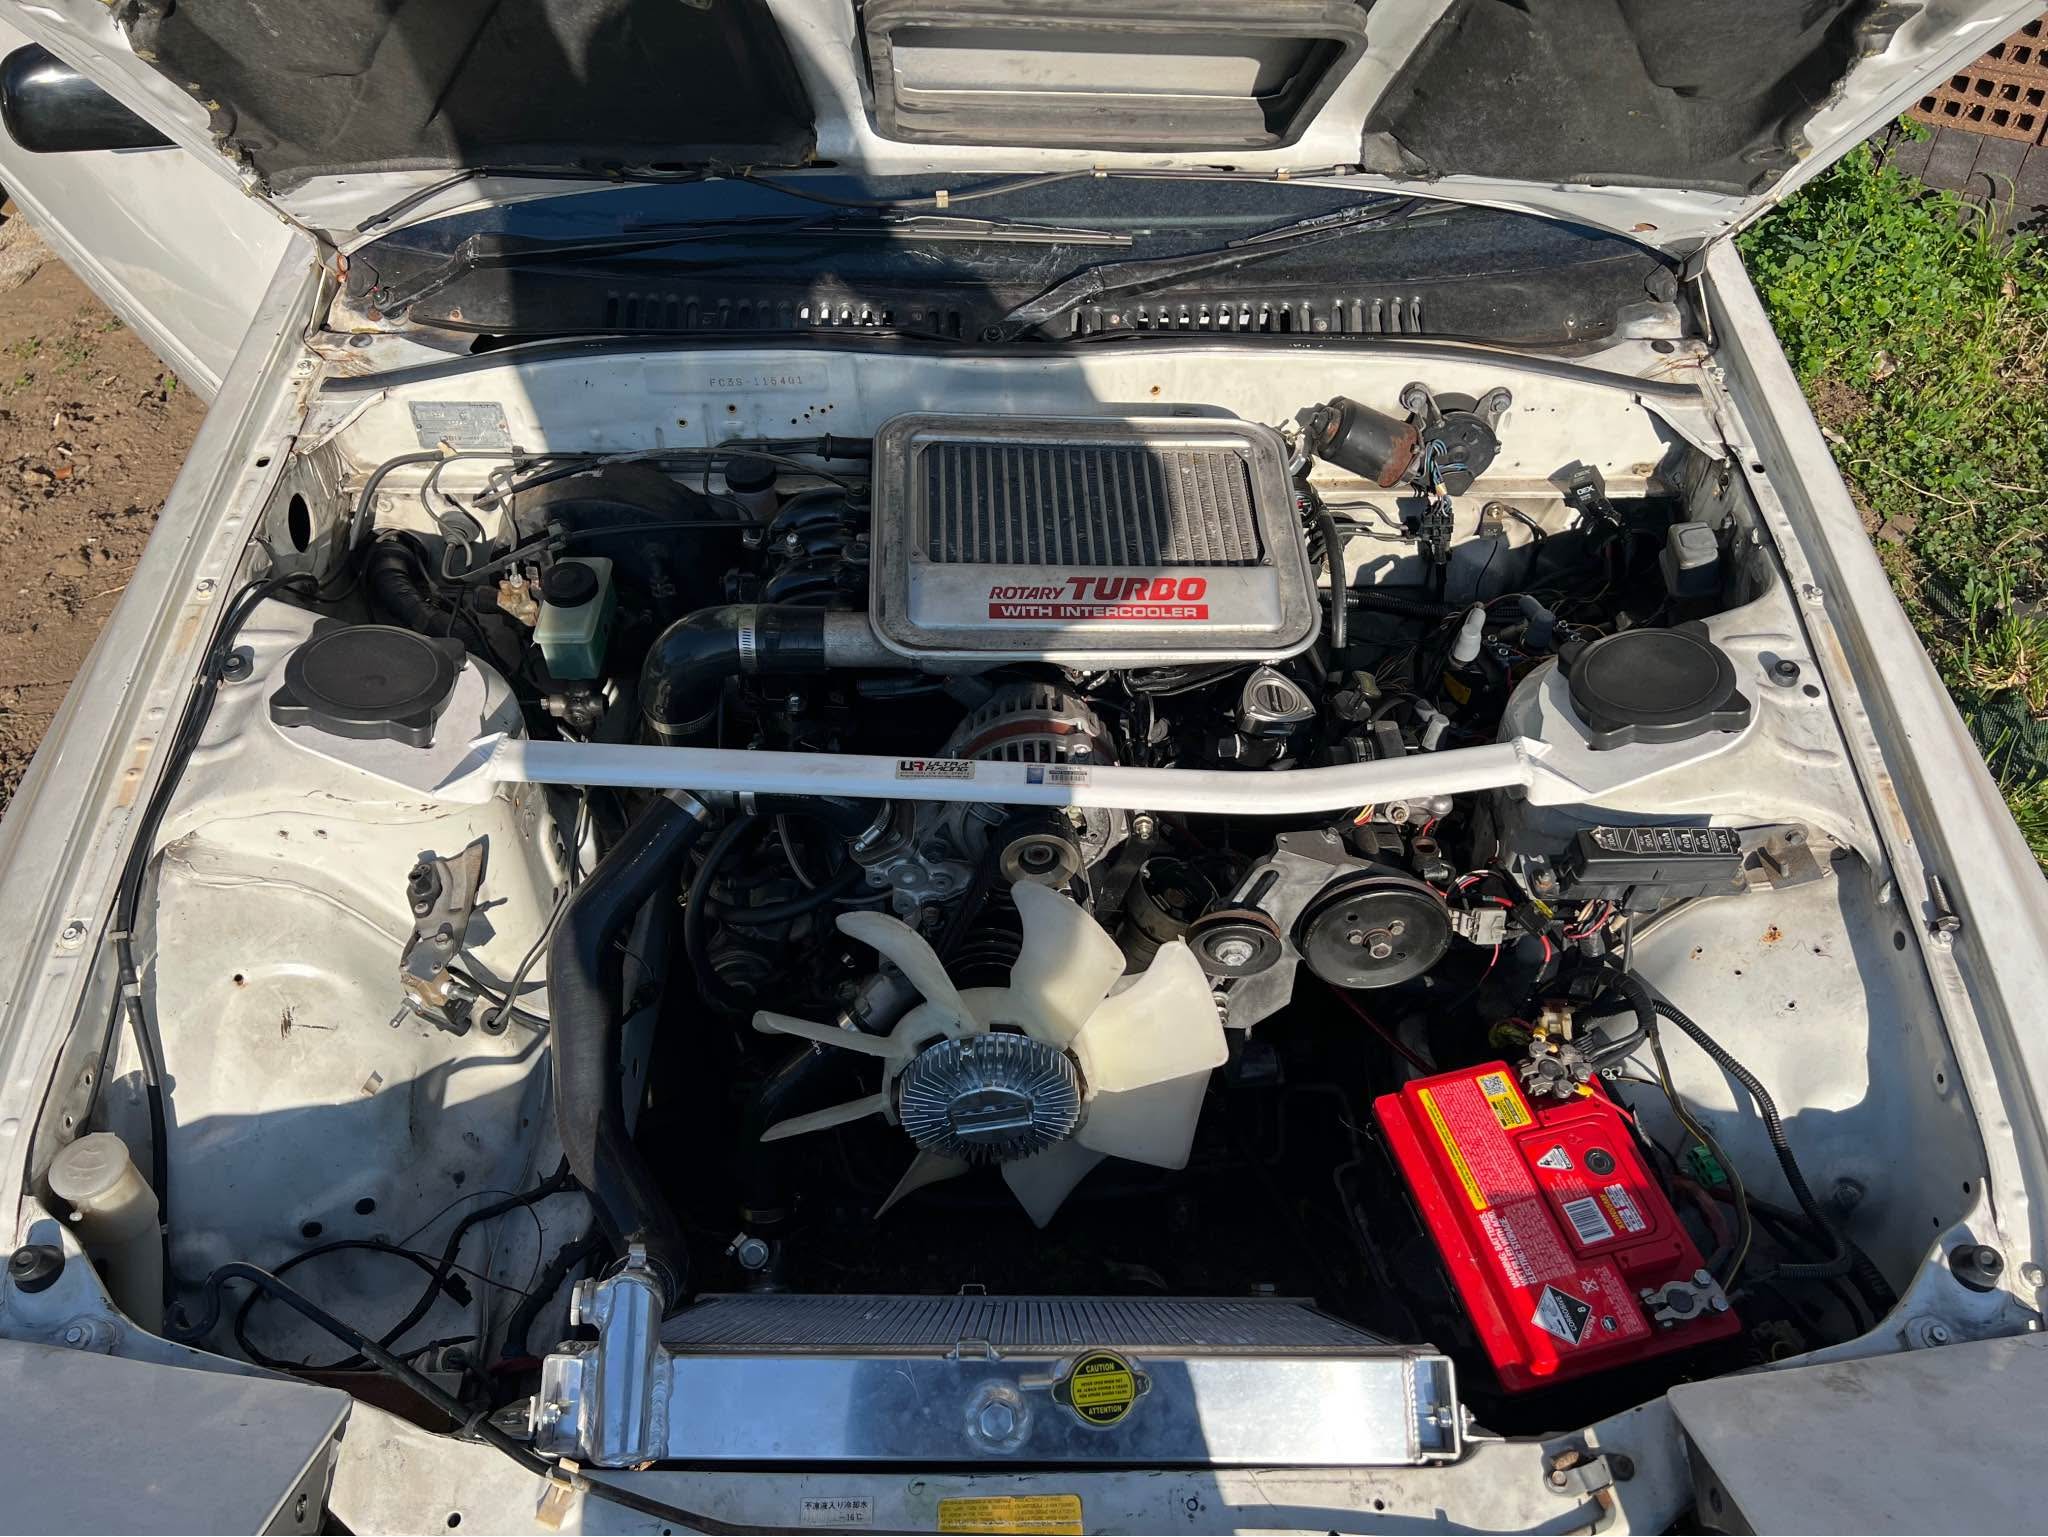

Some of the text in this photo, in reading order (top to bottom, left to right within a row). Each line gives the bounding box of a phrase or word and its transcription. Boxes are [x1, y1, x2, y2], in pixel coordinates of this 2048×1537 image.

[989, 577, 1208, 601] ROTARY TURBO
[1000, 605, 1198, 617] WITH INTERCOOLER
[1661, 832, 1673, 849] 100A
[1700, 834, 1710, 849] 60A
[1718, 834, 1729, 849] 30A
[1494, 1227, 1511, 1247] WITH
[1503, 1245, 1522, 1270] FILLED
[1495, 1250, 1522, 1288] WARNING:
[1514, 1249, 1538, 1284] ELECTRIC
[1514, 1269, 1530, 1286] WET
[1555, 1295, 1577, 1331] CORROSIVE
[1086, 1362, 1115, 1374] CAUTION
[1088, 1405, 1122, 1415] ATTENTION
